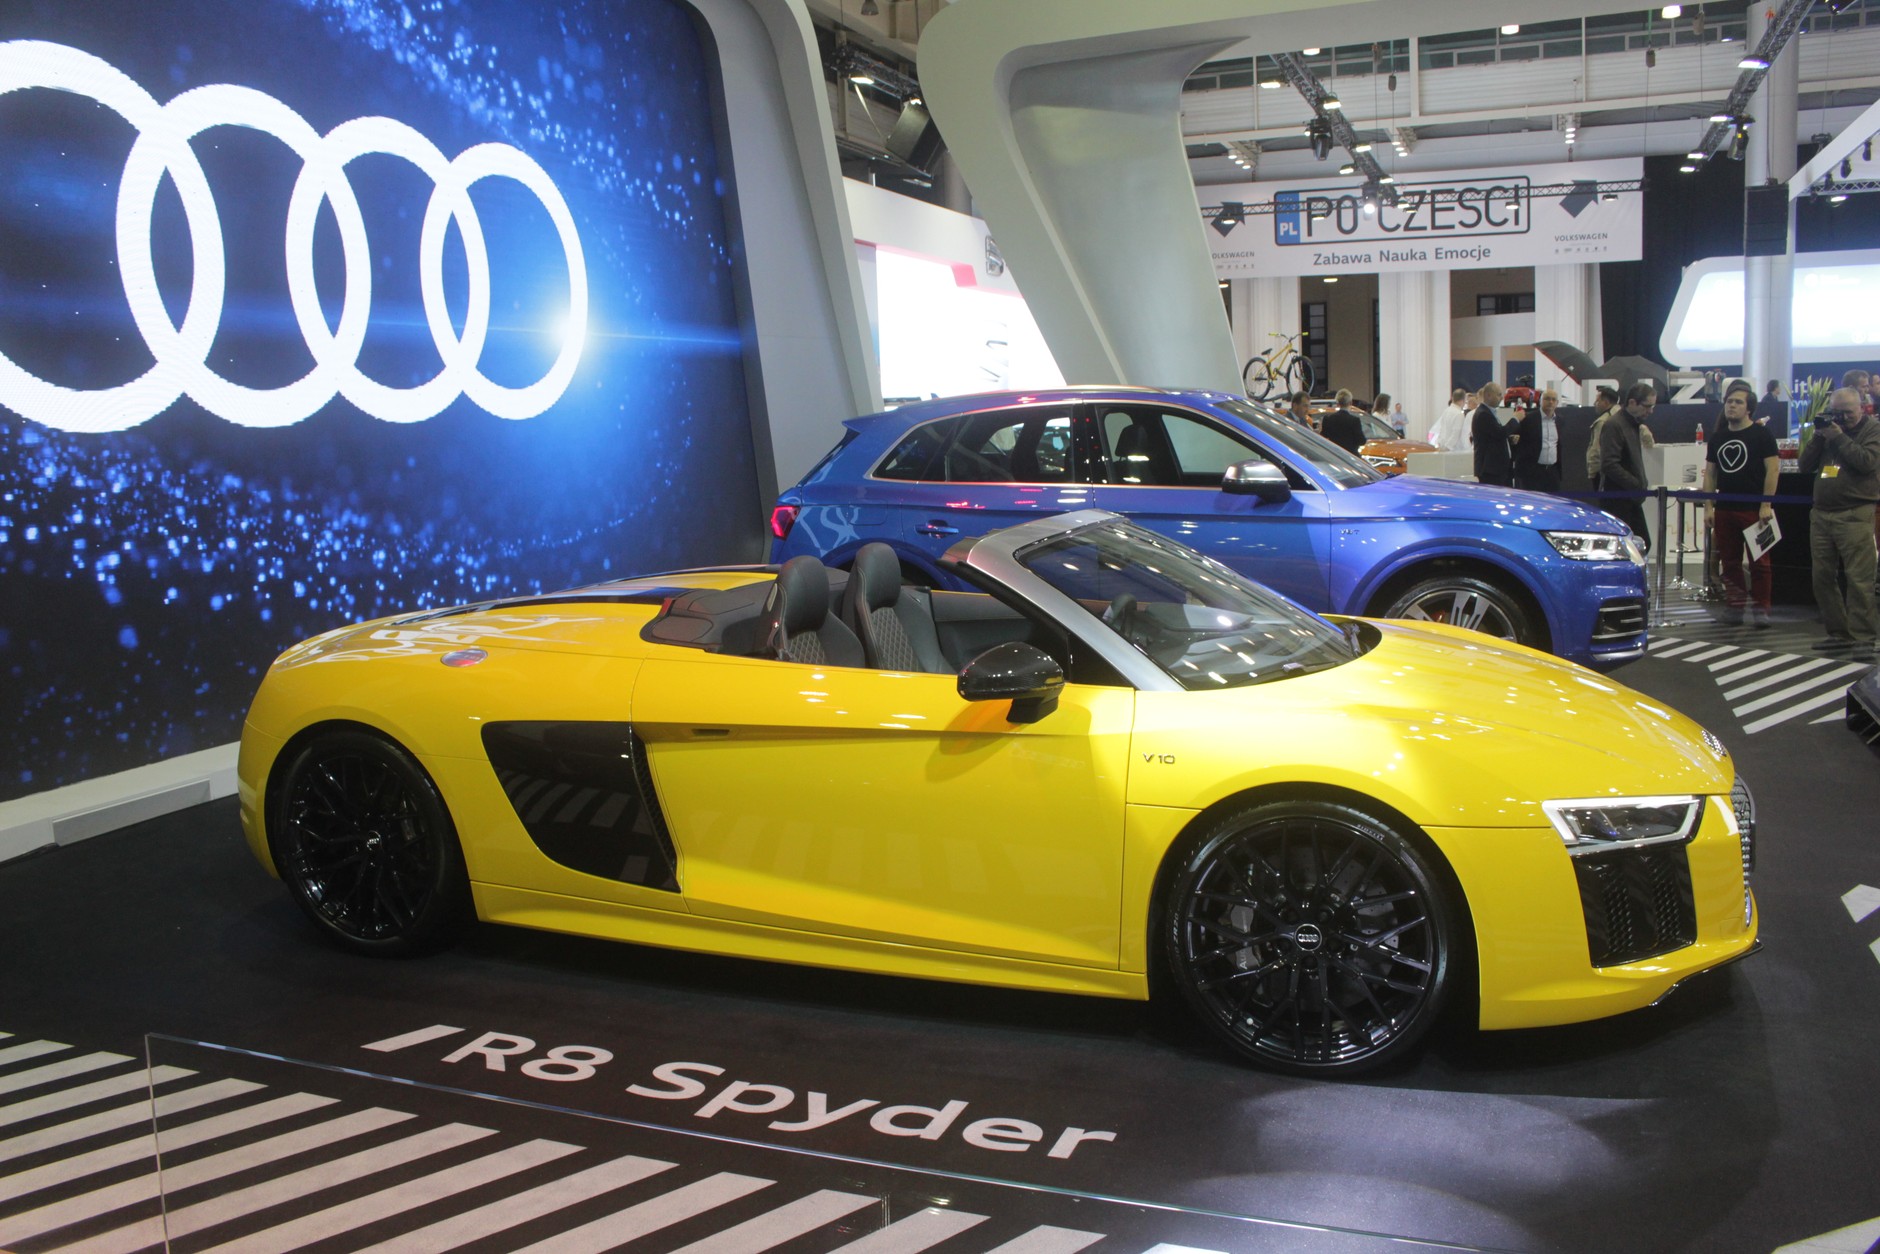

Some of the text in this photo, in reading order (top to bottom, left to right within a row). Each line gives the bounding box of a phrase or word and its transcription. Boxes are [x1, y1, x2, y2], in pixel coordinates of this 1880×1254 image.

[1280, 222, 1298, 236] PL
[1555, 232, 1608, 242] VOLKSWAGEN
[1211, 250, 1255, 259] OLKSWAGEN
[1313, 245, 1491, 266] Zabawa Nauka Emocje
[441, 1031, 1117, 1159] R8 Spyder
